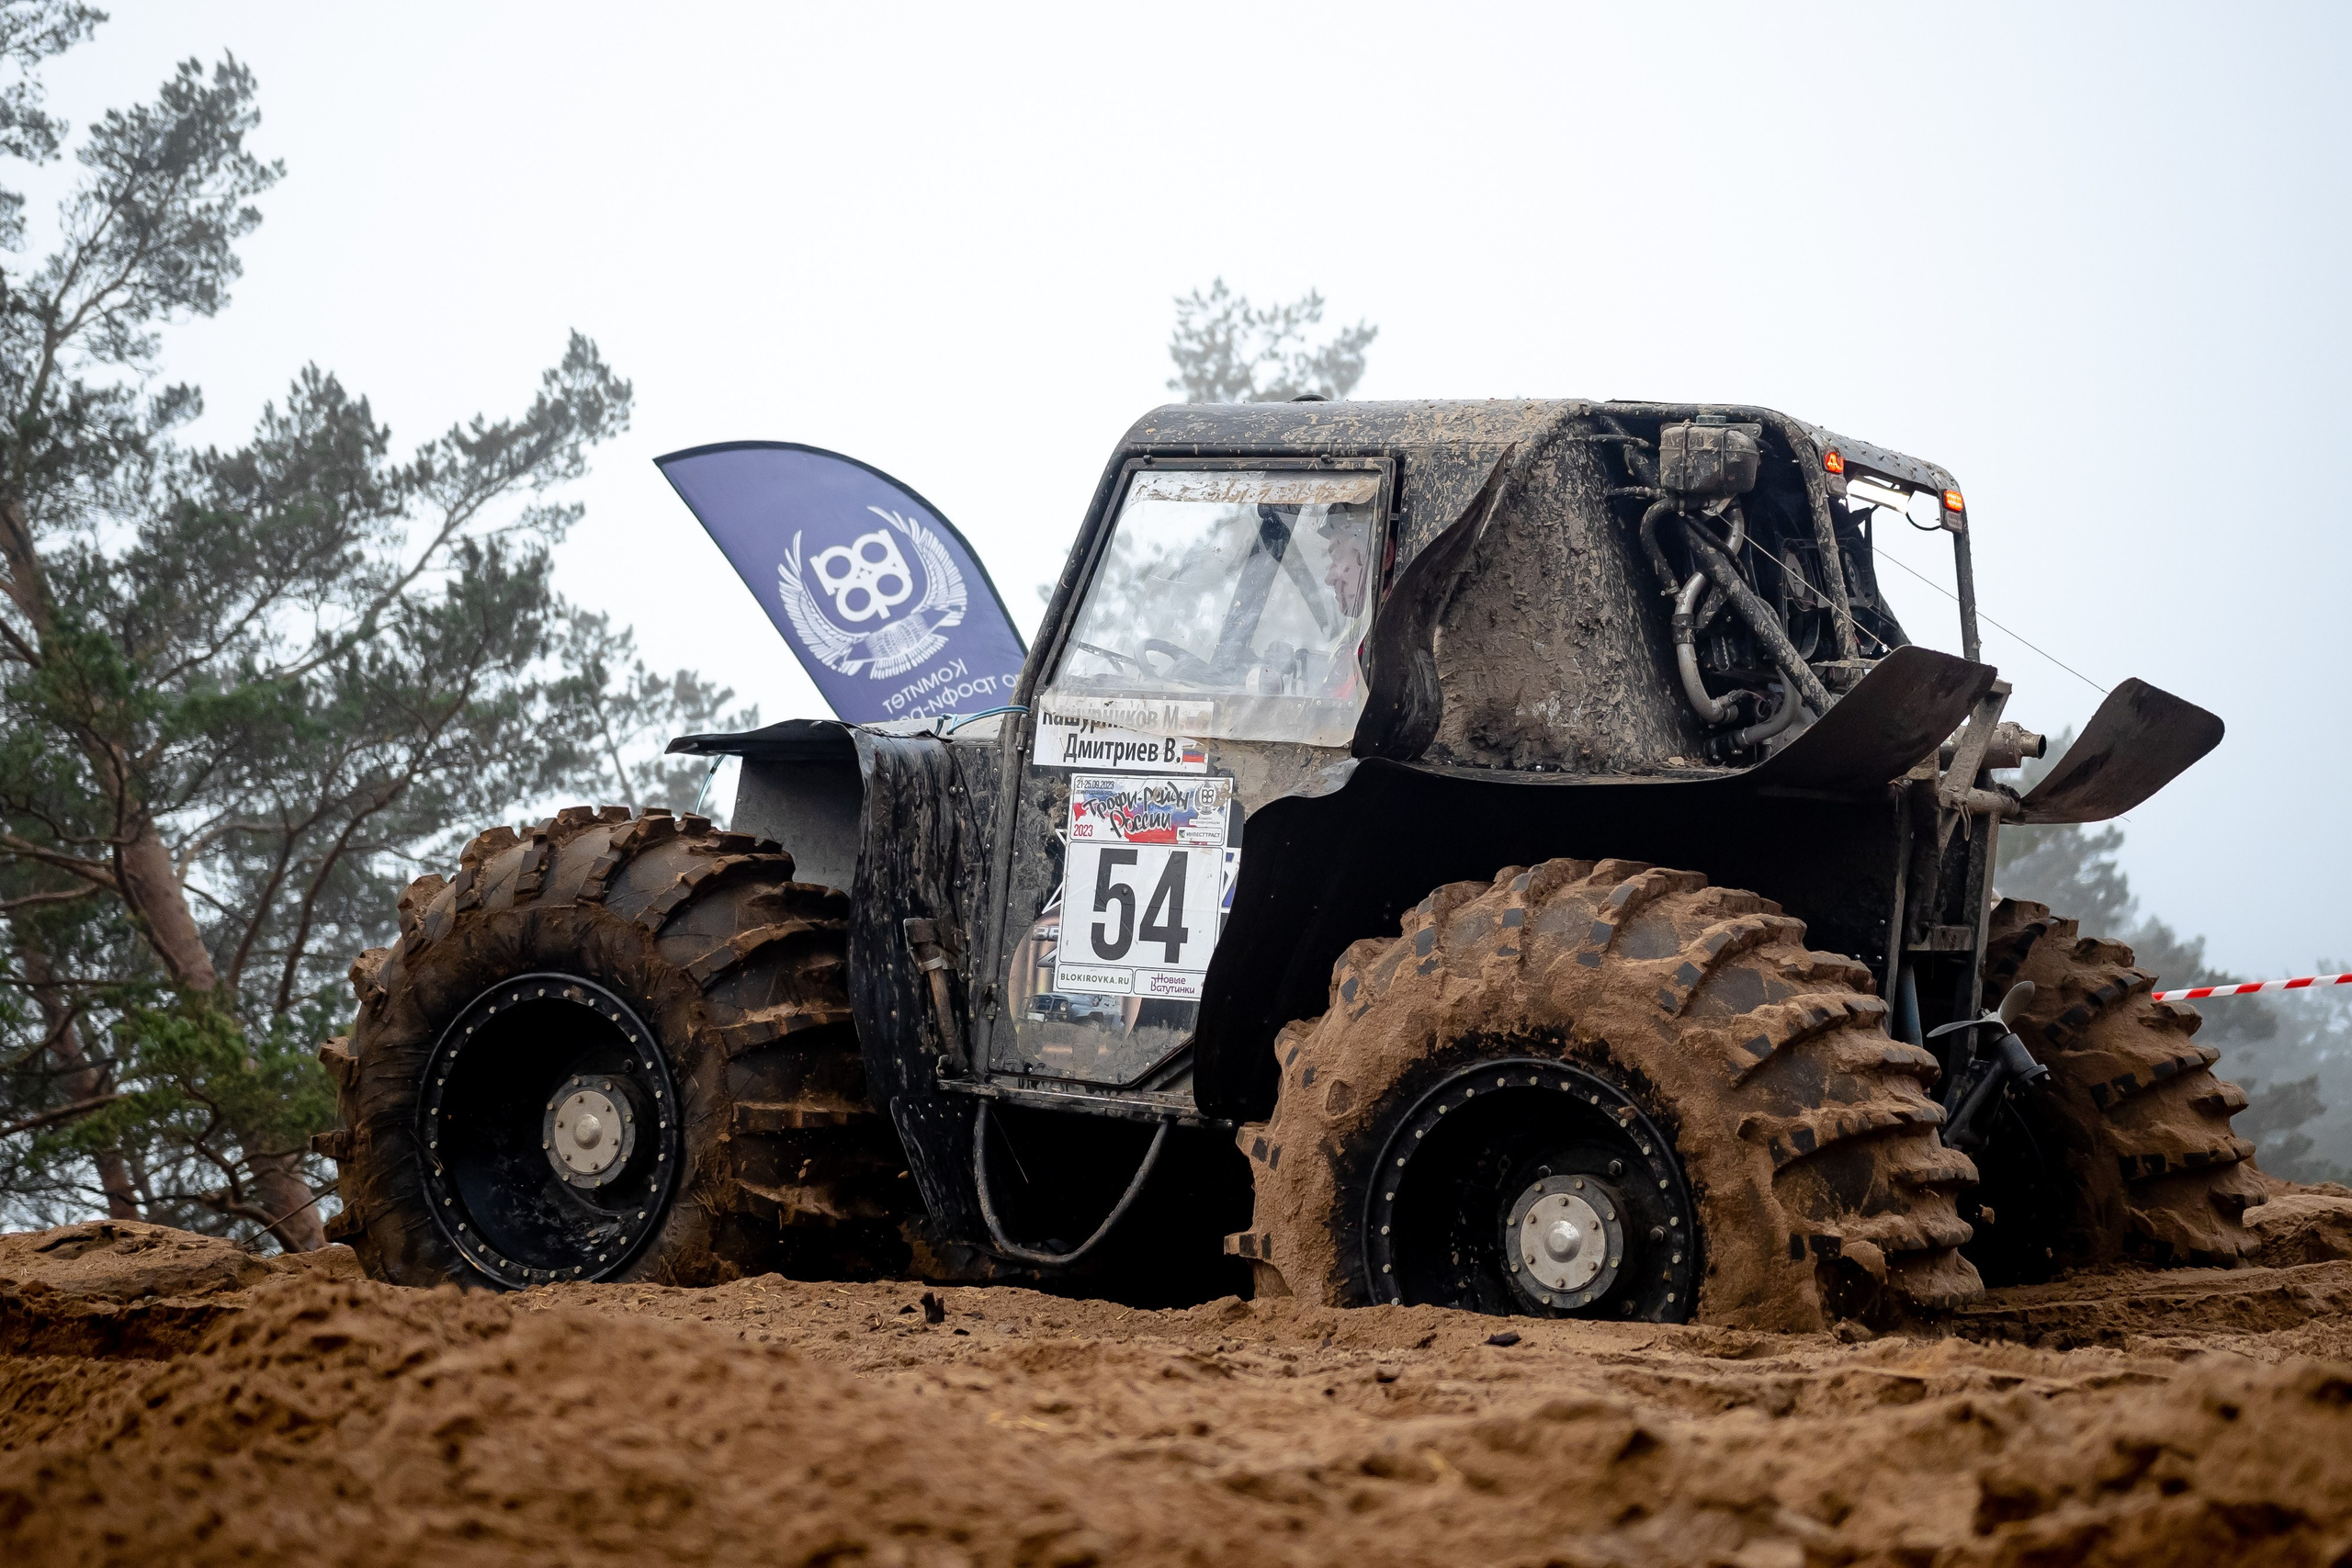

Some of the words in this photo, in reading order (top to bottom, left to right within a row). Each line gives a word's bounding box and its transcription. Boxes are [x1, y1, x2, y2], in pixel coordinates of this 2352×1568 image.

[1063, 733, 1159, 766] Дмитриев
[1163, 738, 1182, 763] В.
[1073, 824, 1093, 837] 2023
[1110, 810, 1171, 838] России
[1091, 847, 1188, 964] 54
[1060, 973, 1129, 985] BLOKIROVKA.RU
[1150, 973, 1186, 985] Новые
[1150, 980, 1195, 995] Ватутинки
